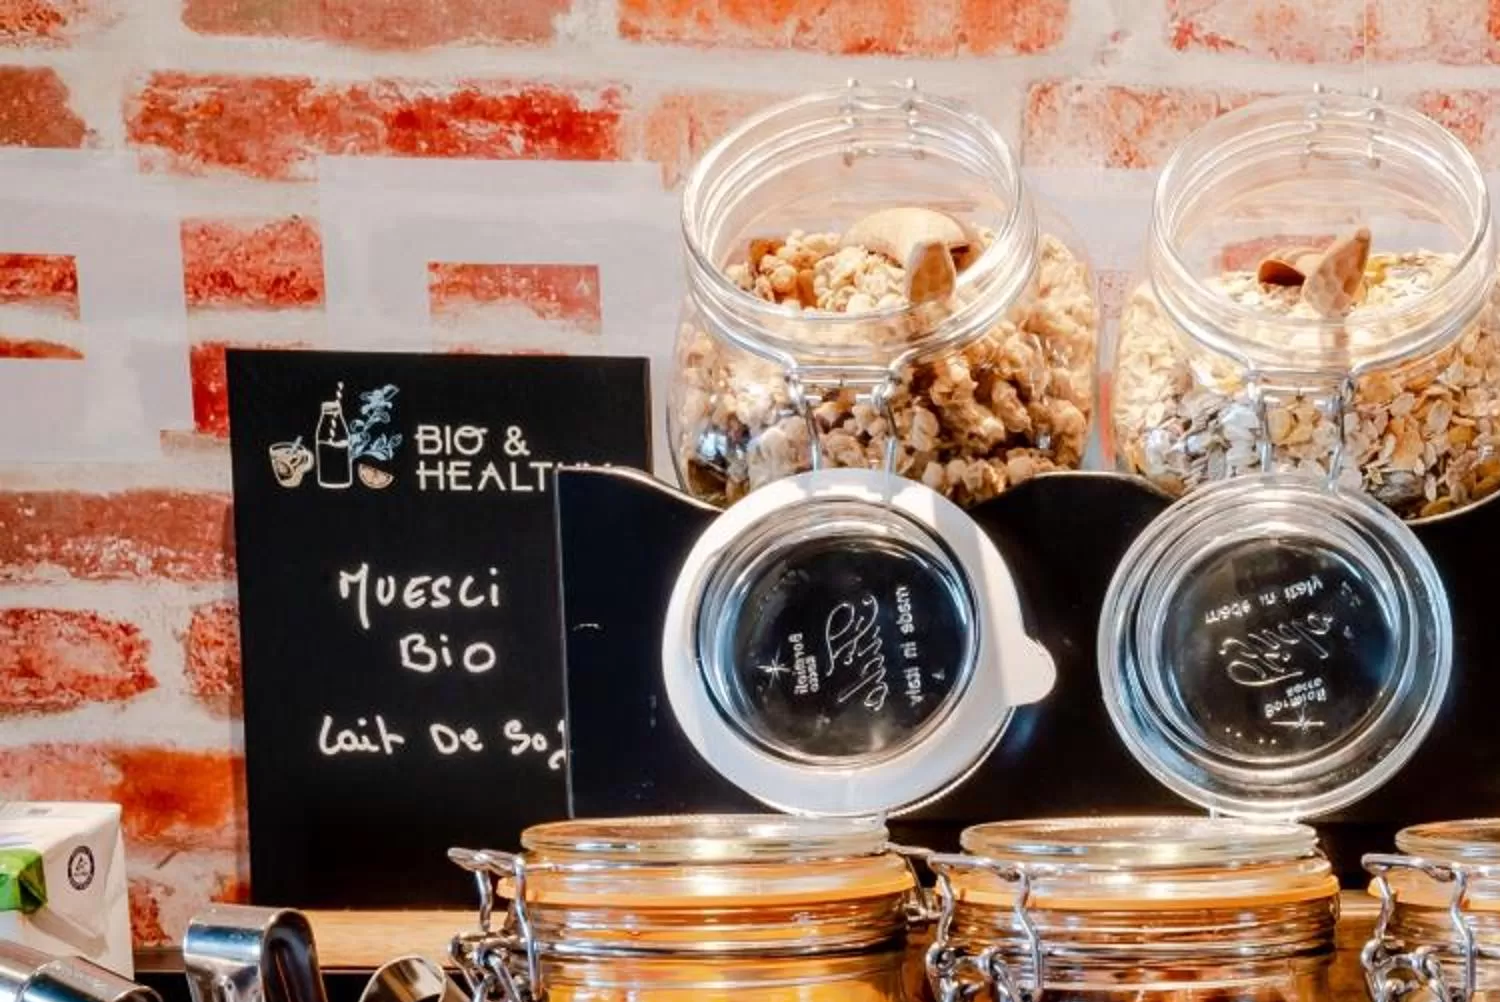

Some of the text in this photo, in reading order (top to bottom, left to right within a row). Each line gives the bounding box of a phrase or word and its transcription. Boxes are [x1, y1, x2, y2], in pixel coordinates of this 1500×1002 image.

[414, 425, 531, 456] BIO &
[416, 460, 611, 491] HEALT
